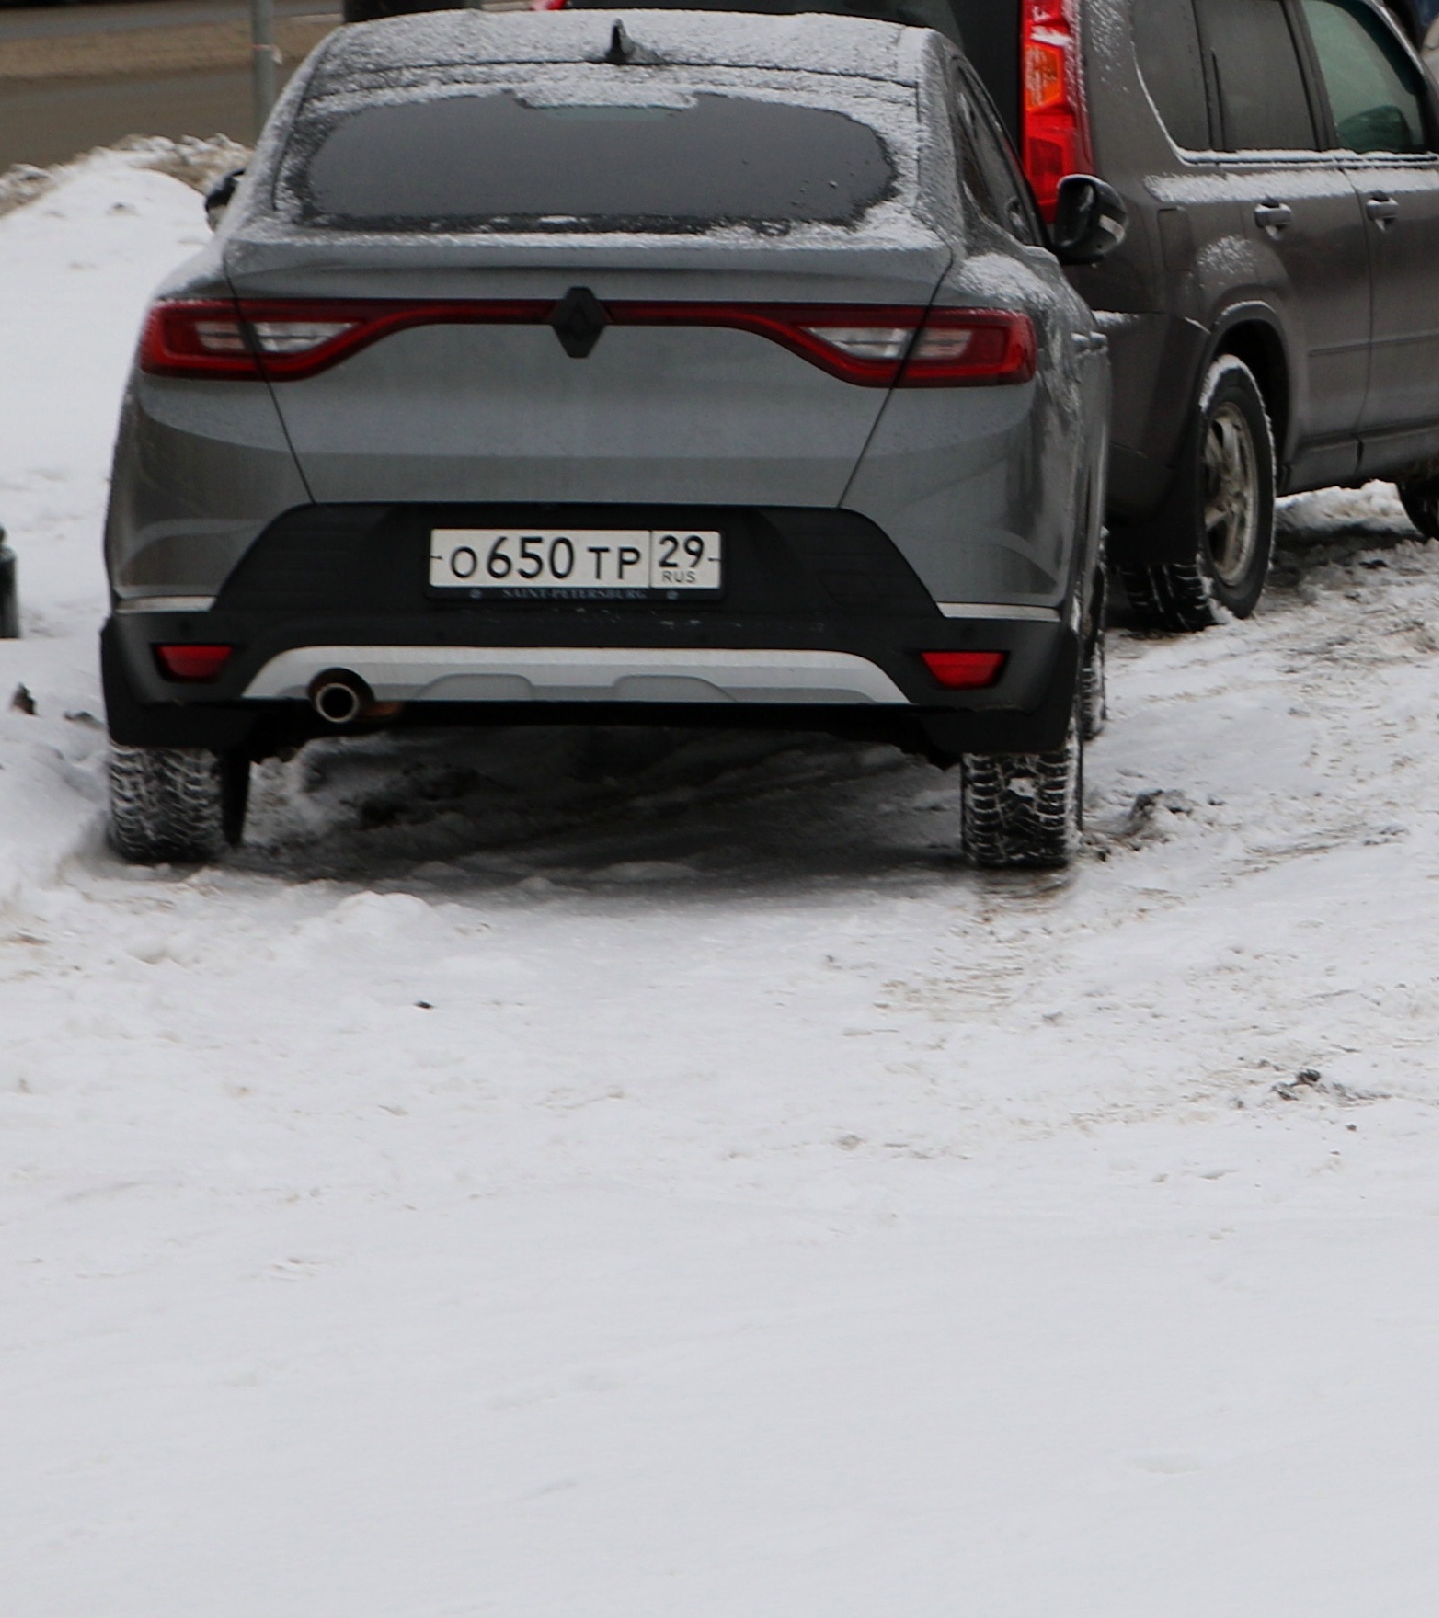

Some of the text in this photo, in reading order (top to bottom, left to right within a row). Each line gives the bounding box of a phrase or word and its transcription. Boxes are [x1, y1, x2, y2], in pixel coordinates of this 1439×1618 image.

[451, 534, 705, 580] О650ТР 29
[661, 570, 697, 584] RUS
